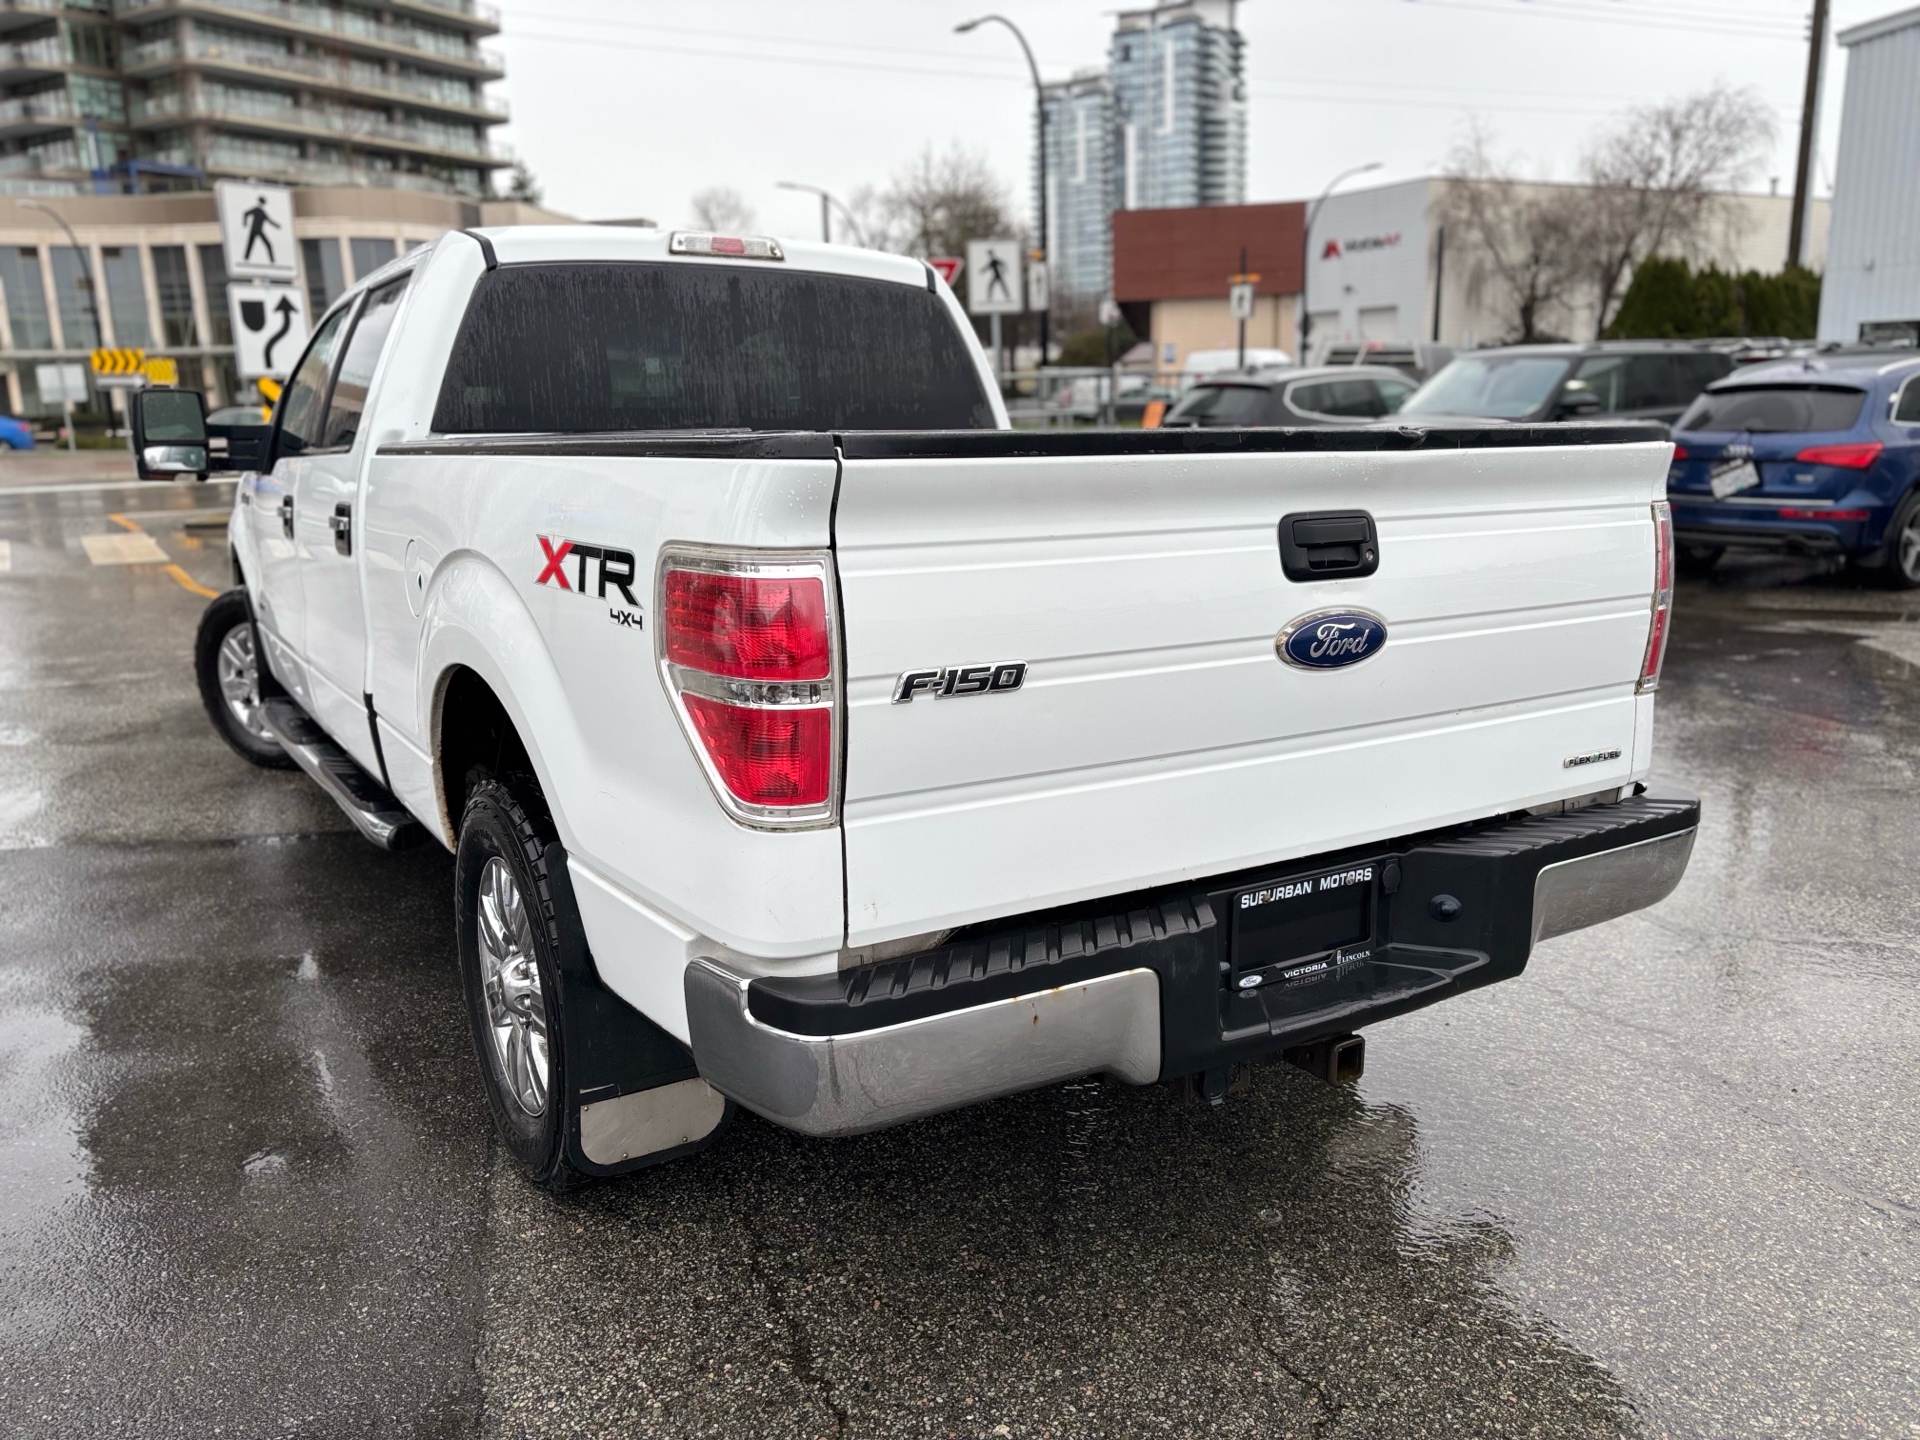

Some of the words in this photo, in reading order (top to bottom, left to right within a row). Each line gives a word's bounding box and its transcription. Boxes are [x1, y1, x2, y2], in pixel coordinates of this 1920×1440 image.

[534, 533, 644, 610] XTR
[1309, 622, 1370, 658] Ford
[891, 659, 1029, 705] F-150
[1568, 755, 1592, 768] FLEX
[1597, 749, 1621, 761] FUEL
[1319, 867, 1373, 891] MOTORS
[1341, 949, 1371, 963] LINCOLN
[1283, 962, 1328, 978] VICTORIA
